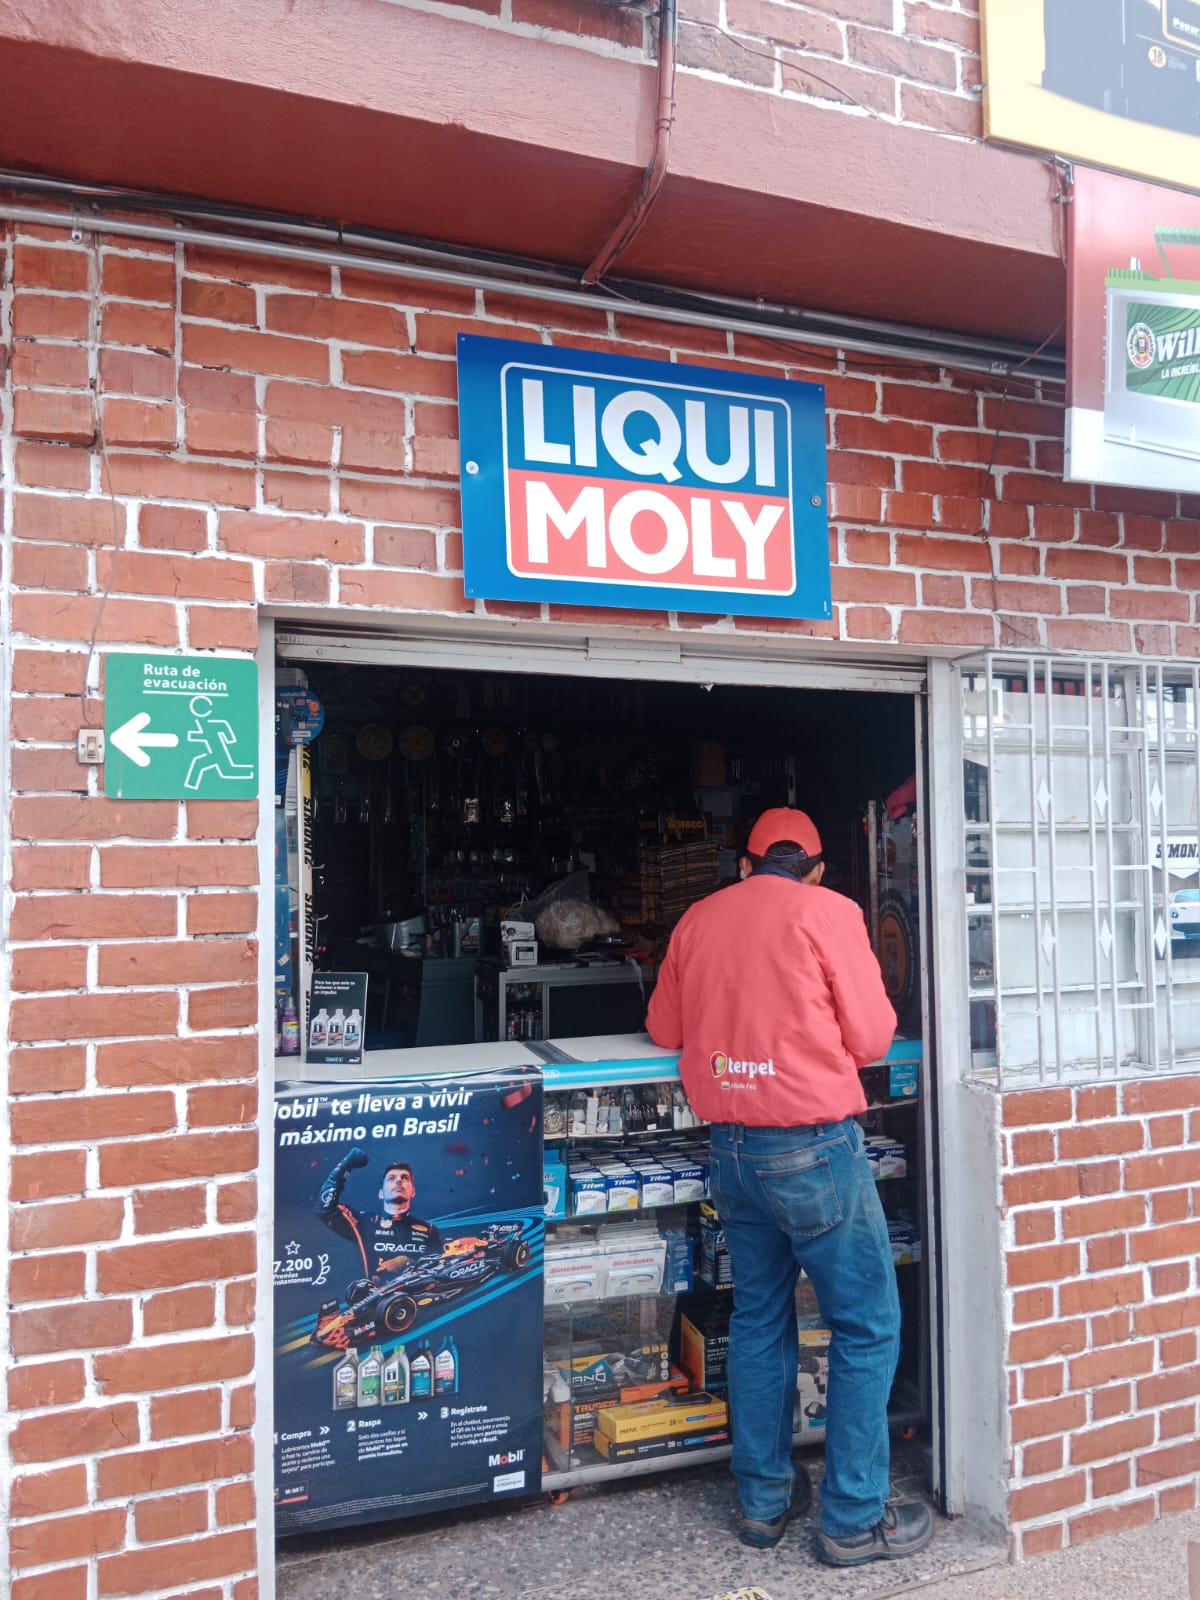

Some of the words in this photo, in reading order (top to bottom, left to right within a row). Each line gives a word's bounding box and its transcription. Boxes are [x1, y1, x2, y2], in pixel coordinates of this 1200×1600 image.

[1160, 367, 1170, 379] LA
[522, 378, 776, 487] LIQUI
[525, 480, 785, 581] MOLY
[144, 663, 178, 677] Ruta
[182, 665, 201, 677] de
[143, 678, 227, 691] evacuación
[1155, 843, 1200, 859] SMON
[728, 1057, 776, 1079] terpel
[331, 1098, 352, 1115] te
[357, 1093, 406, 1114] lleva
[411, 1095, 423, 1109] a
[429, 1087, 473, 1108] vivir
[280, 1123, 366, 1146] máximo
[372, 1123, 397, 1138] en
[403, 1113, 460, 1136] Brasil
[650, 1174, 671, 1182] Titan
[681, 1170, 702, 1178] Titan
[374, 1242, 427, 1252] ORACLE
[450, 1260, 485, 1278] ORACLE
[354, 1321, 375, 1336] Mobil
[440, 1406, 449, 1419] 3
[346, 1420, 356, 1432] 2
[359, 1419, 381, 1428] Raspa
[281, 1430, 312, 1440] Compra
